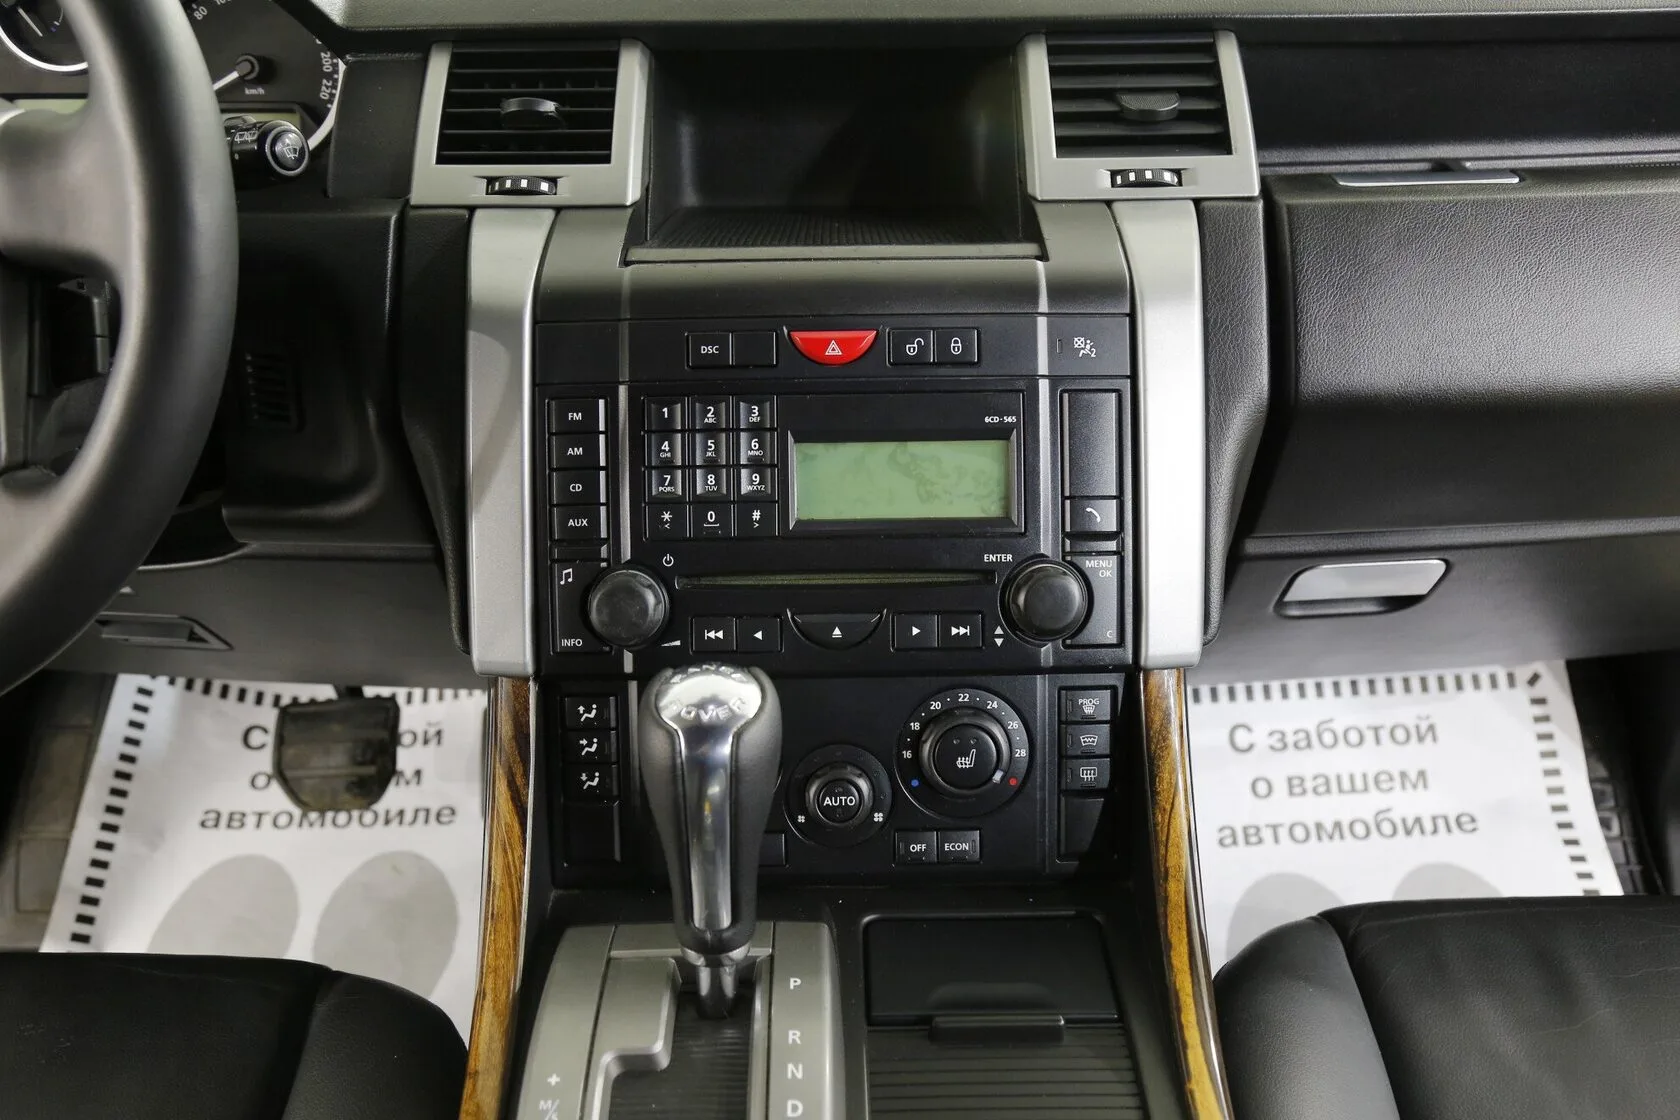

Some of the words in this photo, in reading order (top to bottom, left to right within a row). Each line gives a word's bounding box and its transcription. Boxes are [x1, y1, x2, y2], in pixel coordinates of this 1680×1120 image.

[193, 6, 208, 20] 80
[320, 51, 333, 73] 200
[319, 79, 333, 100] 220
[700, 345, 719, 354] DSC
[662, 407, 668, 419] 1
[706, 406, 715, 418] 2
[751, 405, 759, 417] 3
[568, 412, 582, 421] FM
[661, 440, 670, 452] 4
[707, 439, 715, 451] 5
[750, 438, 759, 451] 6
[567, 447, 583, 456] AM
[705, 450, 717, 458] JKL
[747, 449, 764, 457] MNO
[663, 474, 671, 486] 7
[707, 473, 716, 486] 8
[751, 473, 760, 485] 9
[569, 483, 583, 492] CD
[747, 484, 766, 492] WXYZ
[707, 510, 716, 523] 0
[567, 518, 588, 527] AUX
[983, 553, 1013, 563] ENTER
[1085, 559, 1113, 569] MENU
[1098, 569, 1113, 578] OK
[1106, 630, 1115, 639] C
[561, 638, 583, 647] INFO
[958, 693, 970, 702] 22
[1078, 697, 1100, 705] PROG
[929, 701, 942, 710] 20
[986, 700, 999, 710] 24
[909, 721, 921, 731] 18
[1007, 720, 1019, 730] 26
[1268, 715, 1438, 753] заботой
[901, 750, 913, 759] 16
[1014, 748, 1027, 758] 28
[1250, 776, 1274, 799] о
[1286, 768, 1429, 798] вашем
[822, 796, 857, 807] AUTO
[198, 804, 458, 829] автомобиле
[1217, 808, 1479, 849] автомобиле
[909, 843, 927, 853] OFF
[944, 842, 970, 851] ECON
[789, 977, 802, 990] P
[788, 1029, 802, 1045] R
[787, 1062, 803, 1080] N
[786, 1099, 804, 1118] D
